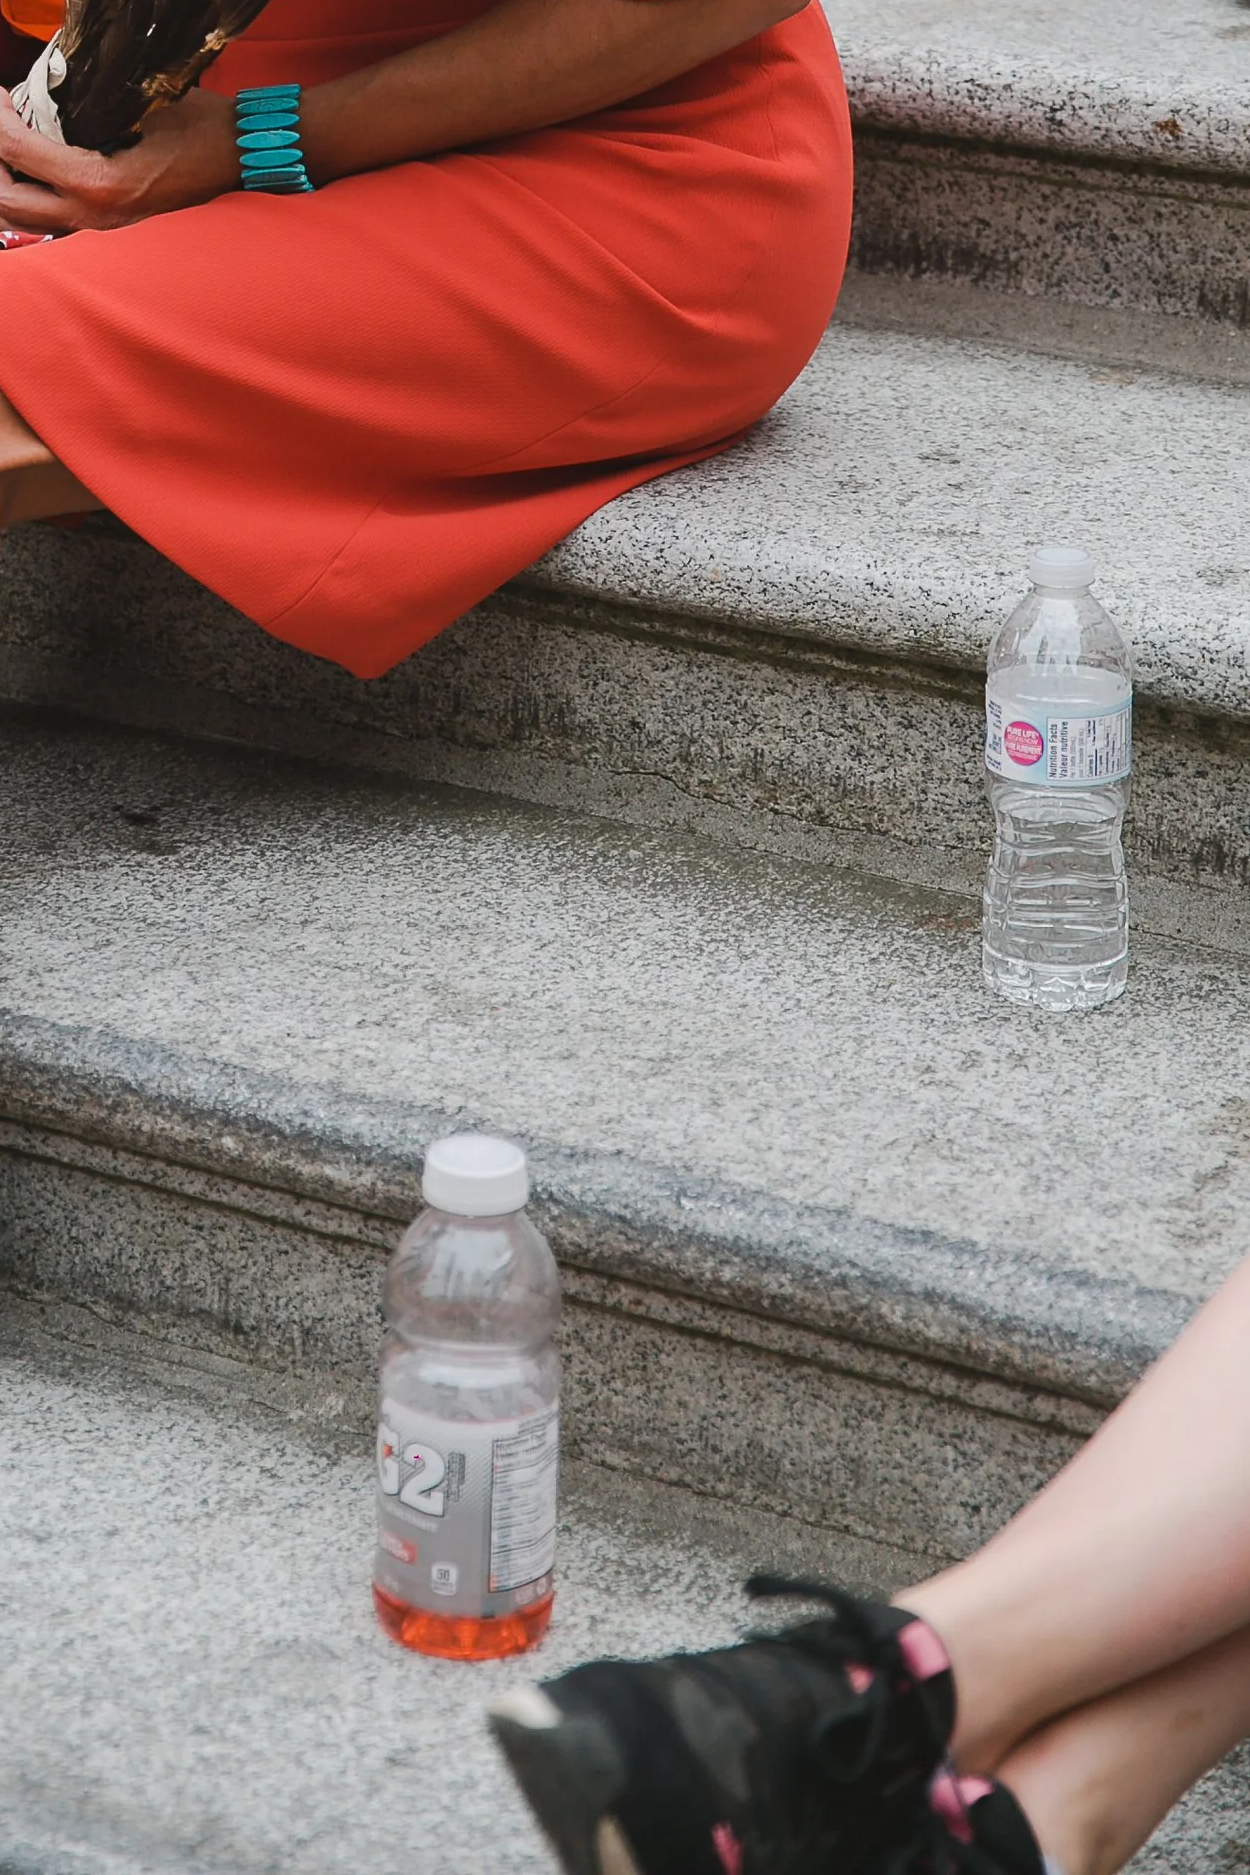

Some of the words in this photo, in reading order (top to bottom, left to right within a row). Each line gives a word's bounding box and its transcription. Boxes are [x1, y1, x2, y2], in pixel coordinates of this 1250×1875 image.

[1048, 723, 1057, 744] Facts
[1059, 721, 1068, 752] nutritive
[1048, 745, 1057, 778] Nutrition
[1059, 753, 1068, 778] Valeur
